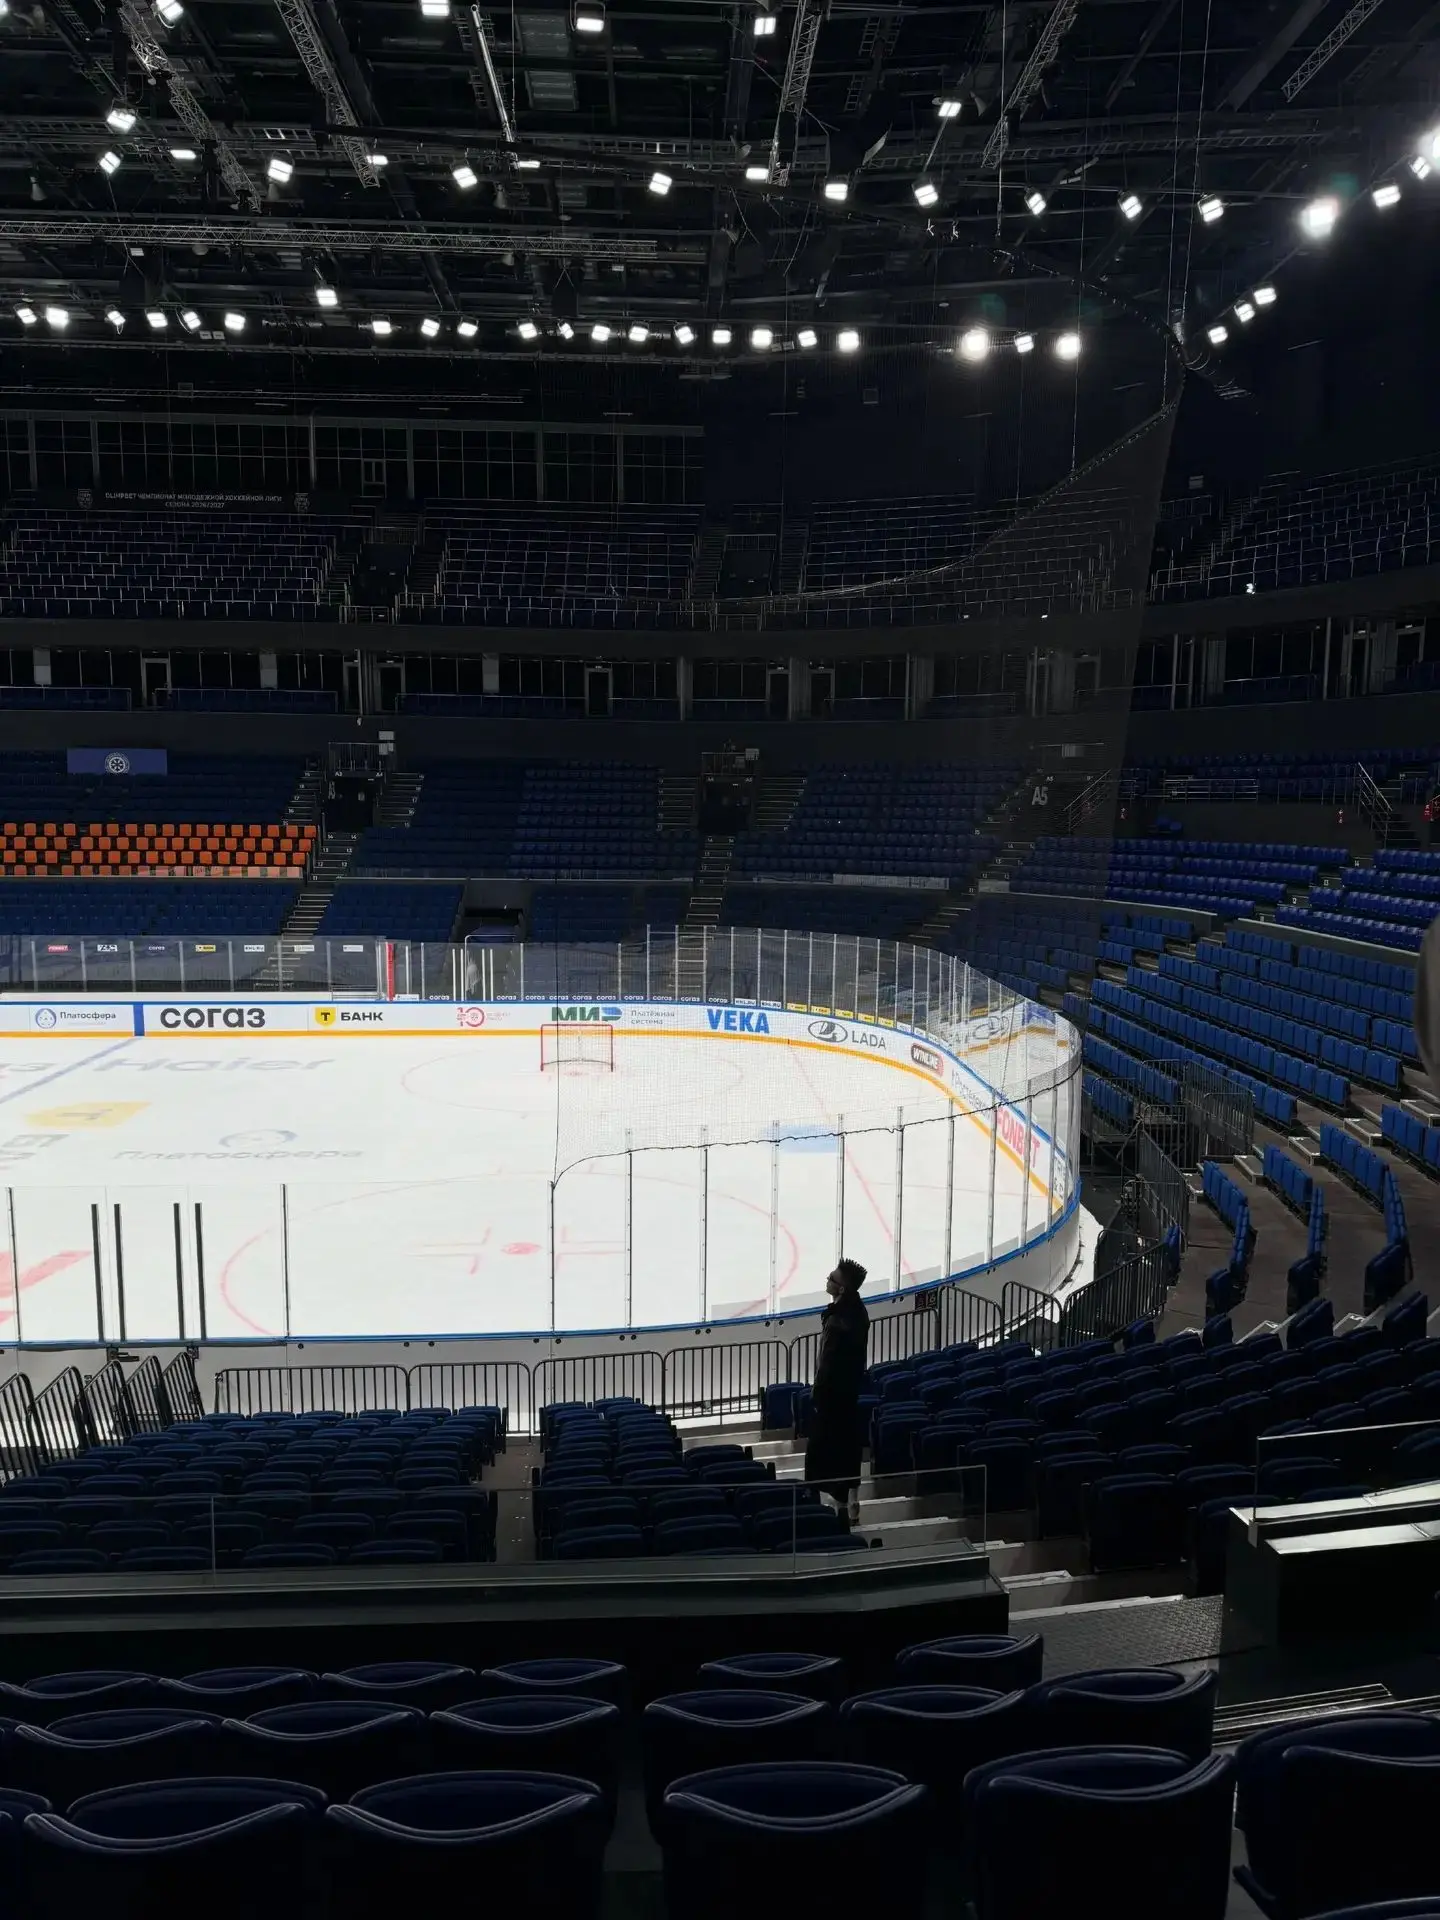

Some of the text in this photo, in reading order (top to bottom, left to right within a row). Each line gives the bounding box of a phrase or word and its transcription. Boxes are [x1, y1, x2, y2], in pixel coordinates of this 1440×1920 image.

[1032, 786, 1049, 806] A5
[60, 1011, 116, 1021] Платосфера
[340, 1012, 383, 1021] БАНК
[552, 1007, 622, 1021] МИР
[707, 1008, 769, 1035] VEKA
[852, 1030, 886, 1050] LADA
[93, 1057, 335, 1072] Haier
[913, 1047, 939, 1070] WINLINE
[111, 1150, 363, 1161] Платосфера
